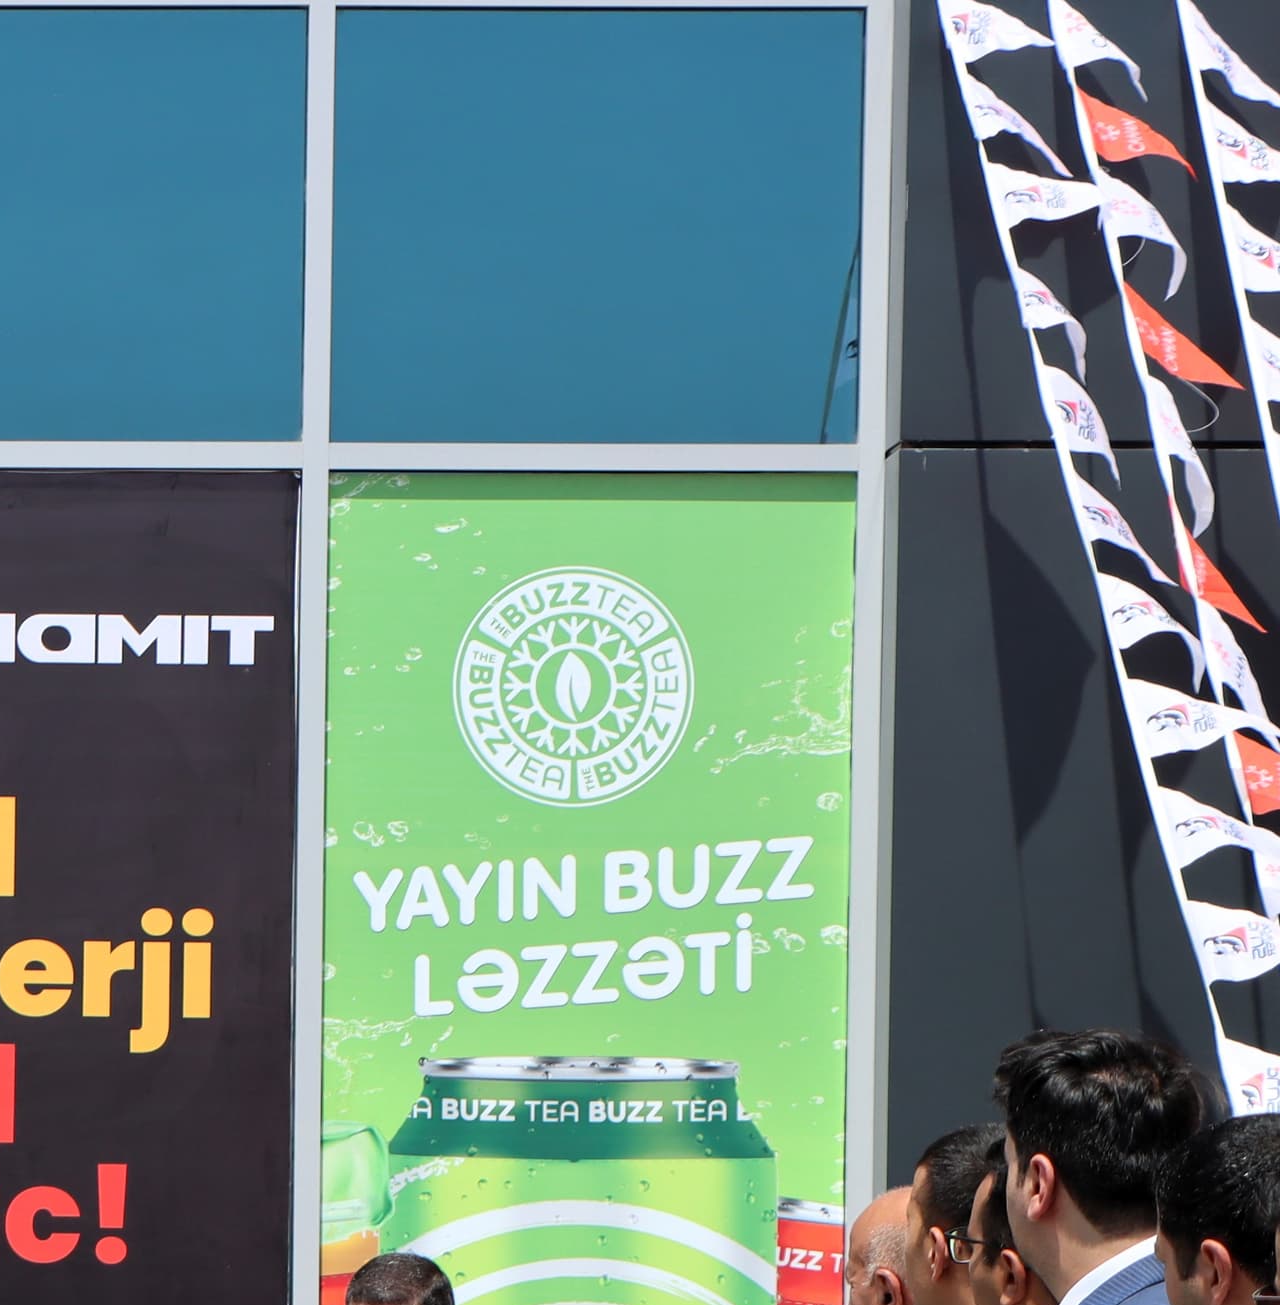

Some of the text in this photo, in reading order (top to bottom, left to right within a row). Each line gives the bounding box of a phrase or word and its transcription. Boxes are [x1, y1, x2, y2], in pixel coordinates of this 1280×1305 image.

[489, 617, 513, 639] THE
[473, 651, 497, 664] THE
[583, 767, 595, 792] THE
[352, 835, 815, 933] YAYIN BUZZ
[413, 912, 753, 1017] LƏZZƏTİ
[441, 1097, 516, 1122] BUZZ
[524, 1100, 580, 1123] TEA
[588, 1101, 664, 1123] BUZZ
[672, 1100, 728, 1122] TEA
[777, 1246, 824, 1271] UZZ
